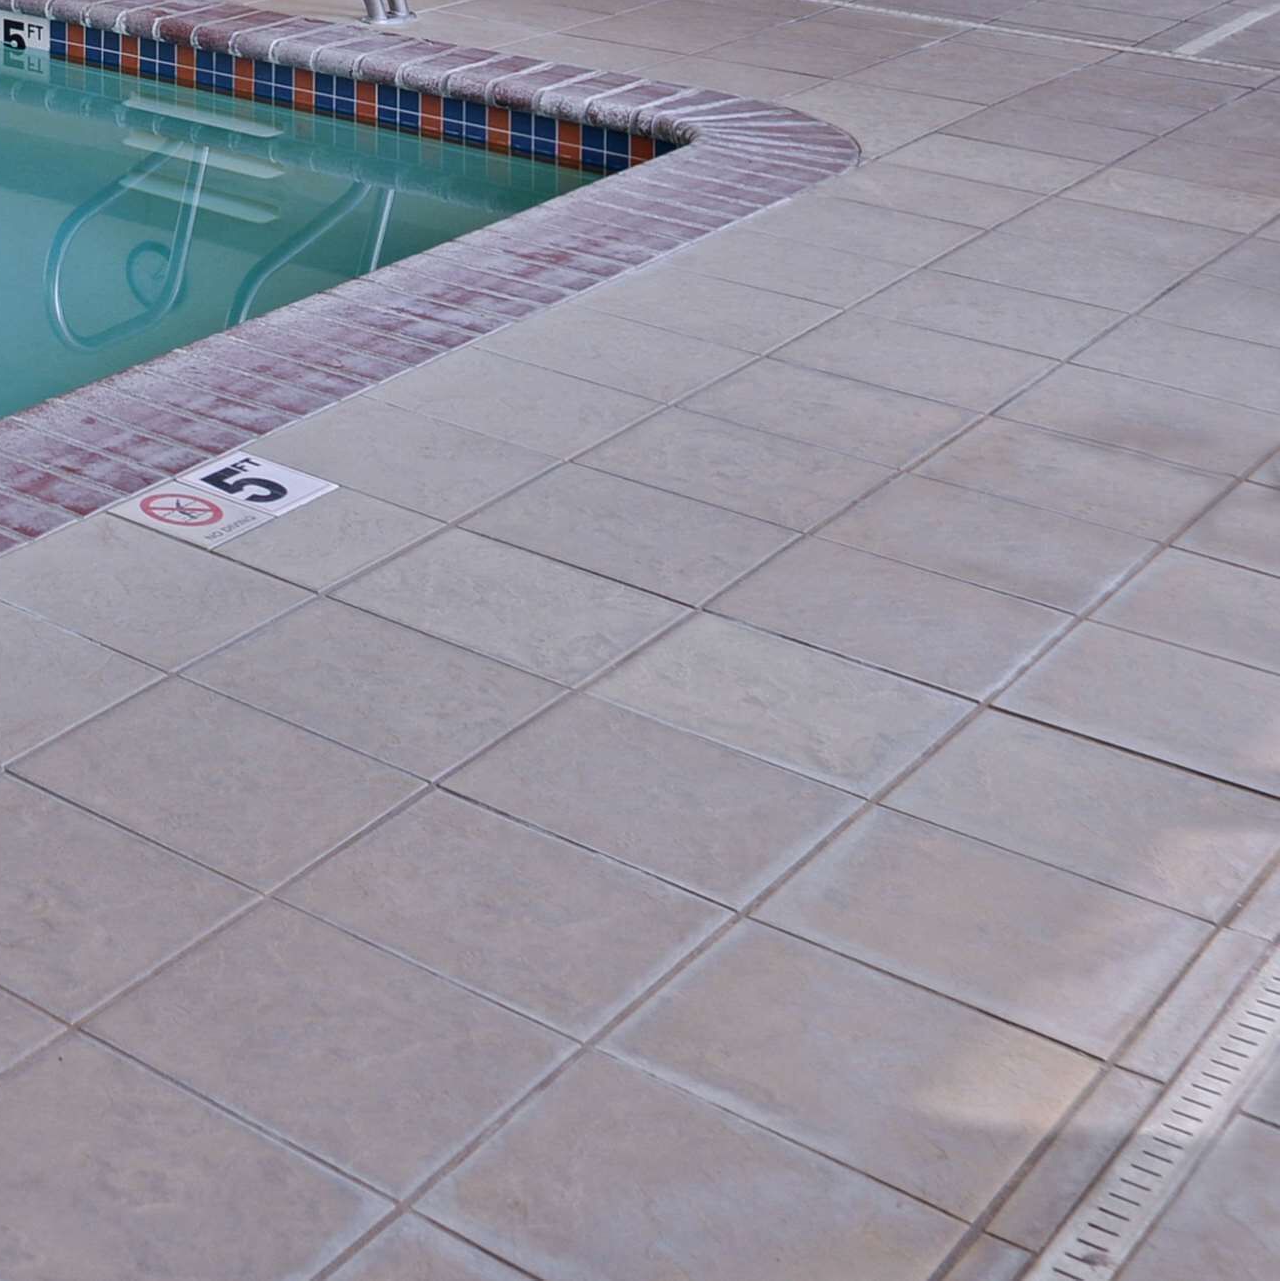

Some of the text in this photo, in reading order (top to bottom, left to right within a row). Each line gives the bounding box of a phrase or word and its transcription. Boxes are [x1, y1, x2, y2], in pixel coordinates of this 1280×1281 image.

[3, 18, 44, 50] 5 FT
[200, 458, 288, 503] 5 FT
